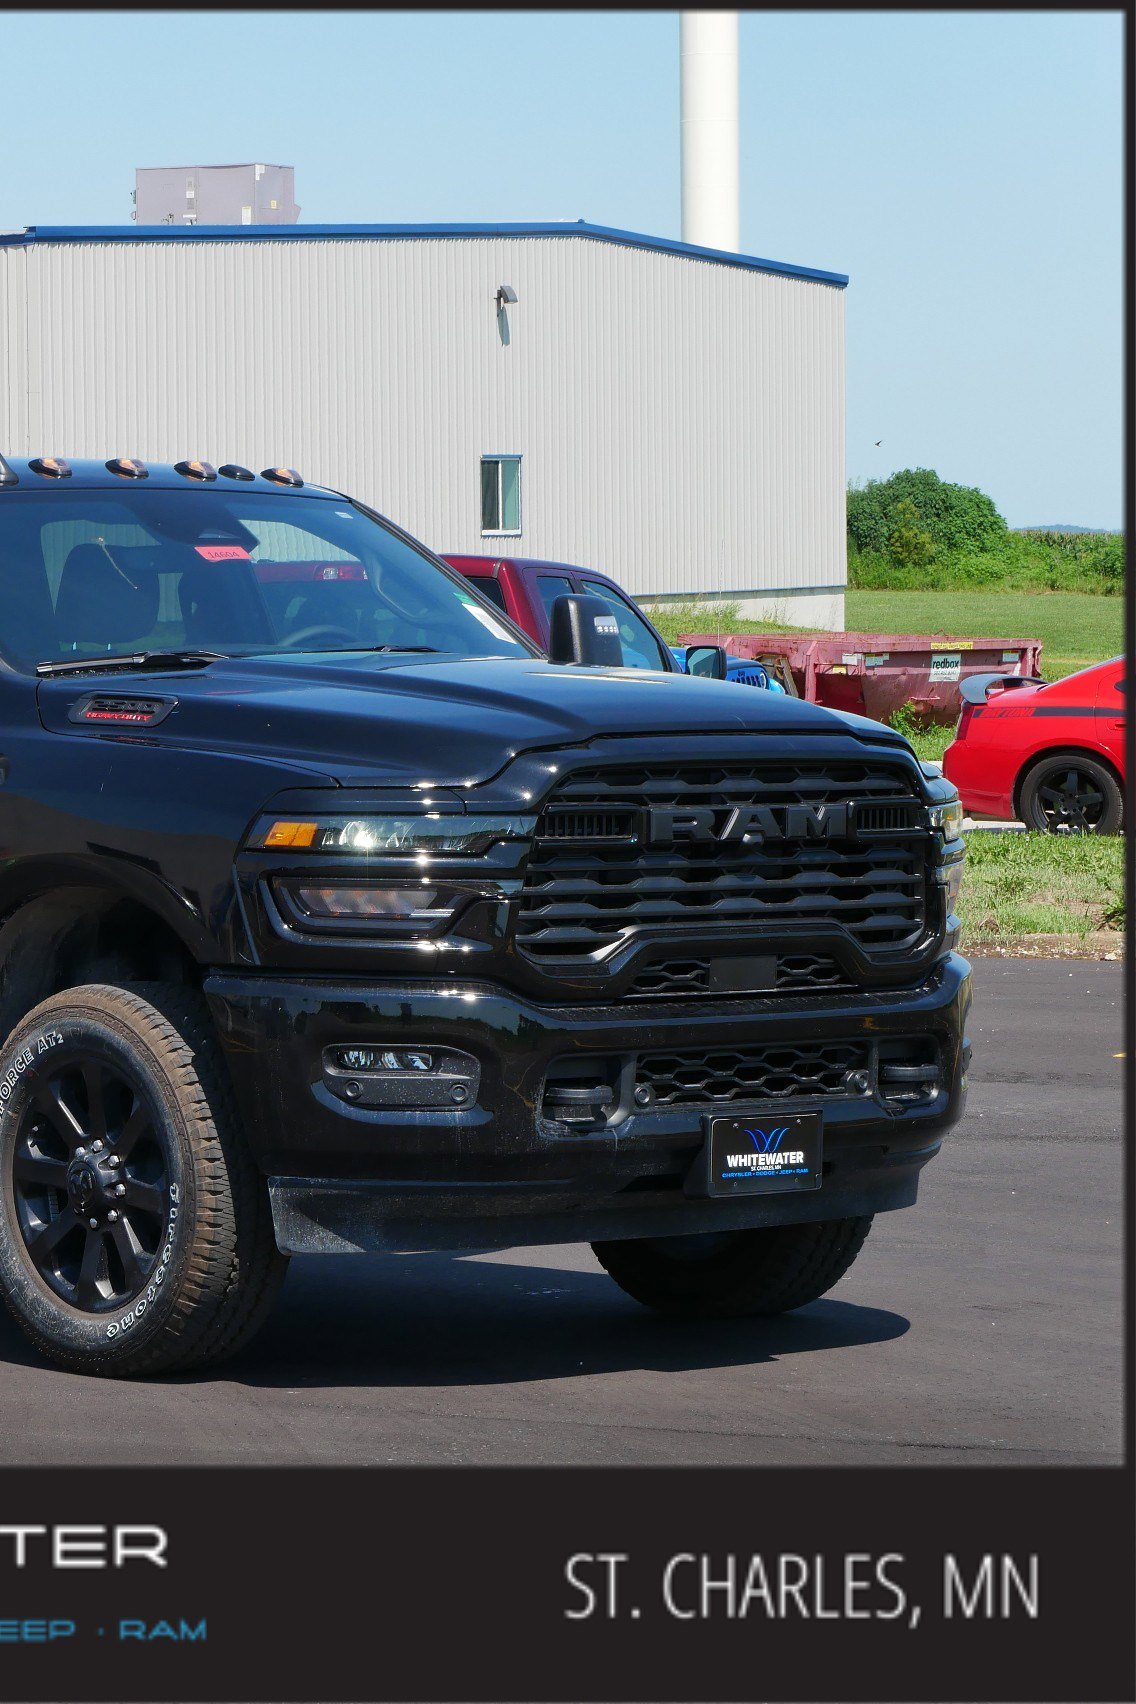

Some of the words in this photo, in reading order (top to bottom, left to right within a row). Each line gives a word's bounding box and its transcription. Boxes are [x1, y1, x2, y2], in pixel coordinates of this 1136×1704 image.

[932, 658, 959, 669] redbox
[650, 804, 847, 841] RAM
[727, 1151, 804, 1168] WHITEWATER
[722, 1171, 753, 1179] CHRYSLER
